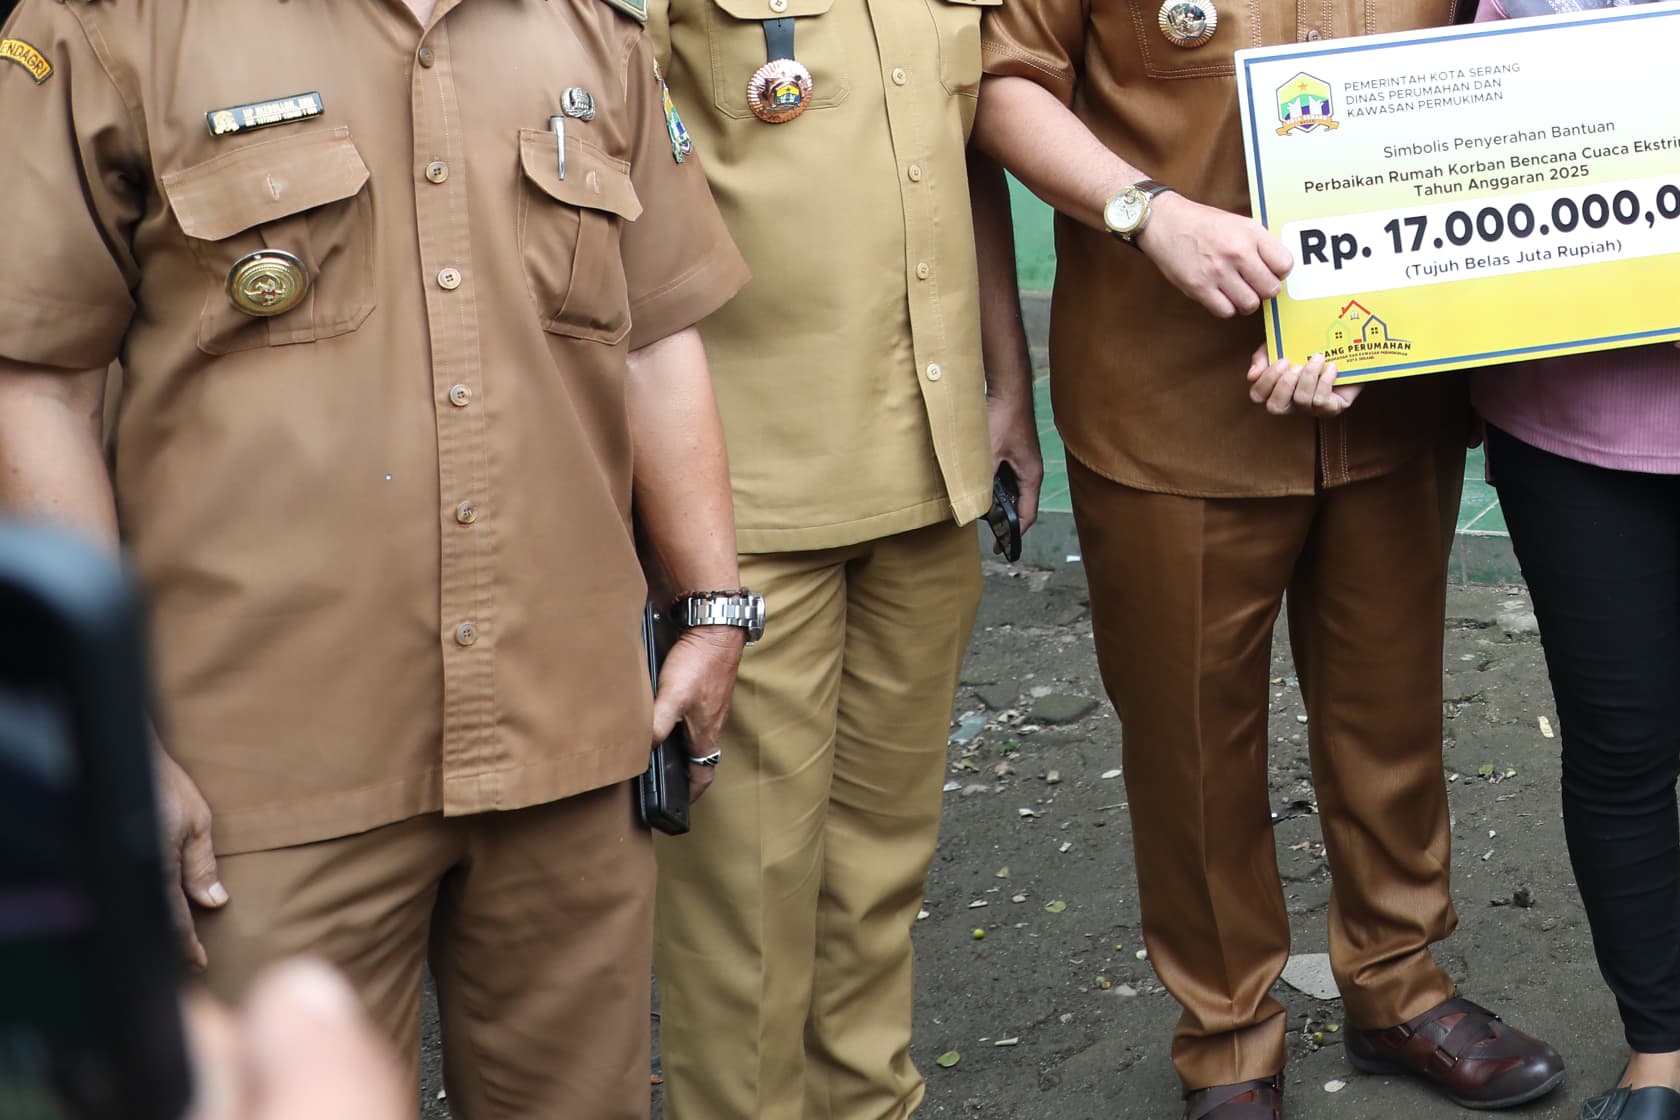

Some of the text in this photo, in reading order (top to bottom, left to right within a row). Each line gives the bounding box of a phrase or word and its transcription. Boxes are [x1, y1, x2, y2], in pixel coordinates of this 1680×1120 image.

[0, 41, 49, 77] ENDAGRI
[1344, 63, 1521, 92] PEMERINTAH KOTA SERANG
[1346, 79, 1502, 106] DINAS PERUMAHAN DAN
[1347, 92, 1503, 118] KAWASAN PERMUKIMAN
[1383, 121, 1615, 159] Simbolis Penyerahan Bantuan
[1304, 174, 1384, 193] Perbaikan
[1389, 166, 1443, 183] Rumah
[1448, 160, 1505, 176] Korban
[1510, 151, 1577, 169] Bencana
[1582, 144, 1629, 159] Cuaca
[1414, 164, 1589, 197] Tahun Anggaran 2025
[1299, 228, 1372, 270] Rp.
[1405, 239, 1622, 279] (Tujuh Belas Juta Rupiah)
[1348, 342, 1411, 352] PERUMAHAN
